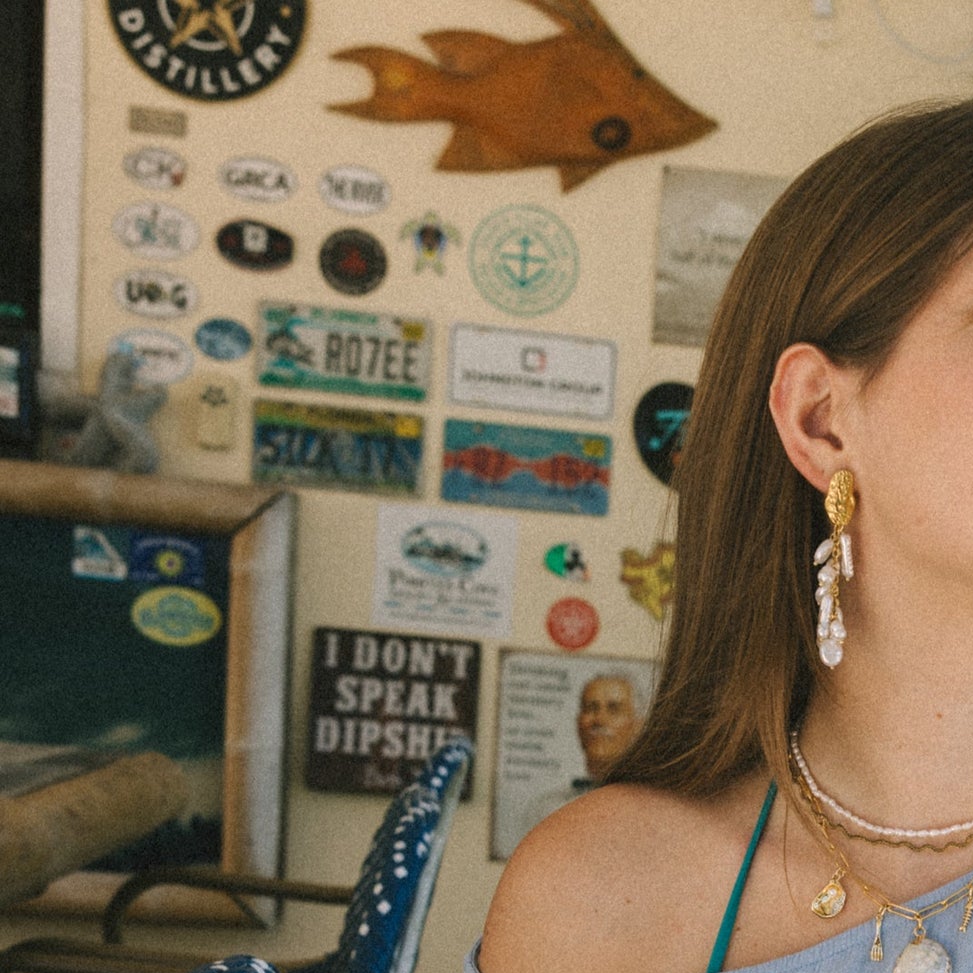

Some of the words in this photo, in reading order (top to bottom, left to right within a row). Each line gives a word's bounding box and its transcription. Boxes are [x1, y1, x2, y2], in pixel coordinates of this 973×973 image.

[118, 7, 292, 94] DISTILLERY
[324, 632, 339, 668] I
[355, 636, 474, 680] DON'T
[334, 675, 458, 721] SPEAK
[314, 716, 470, 759] DIPSHI
